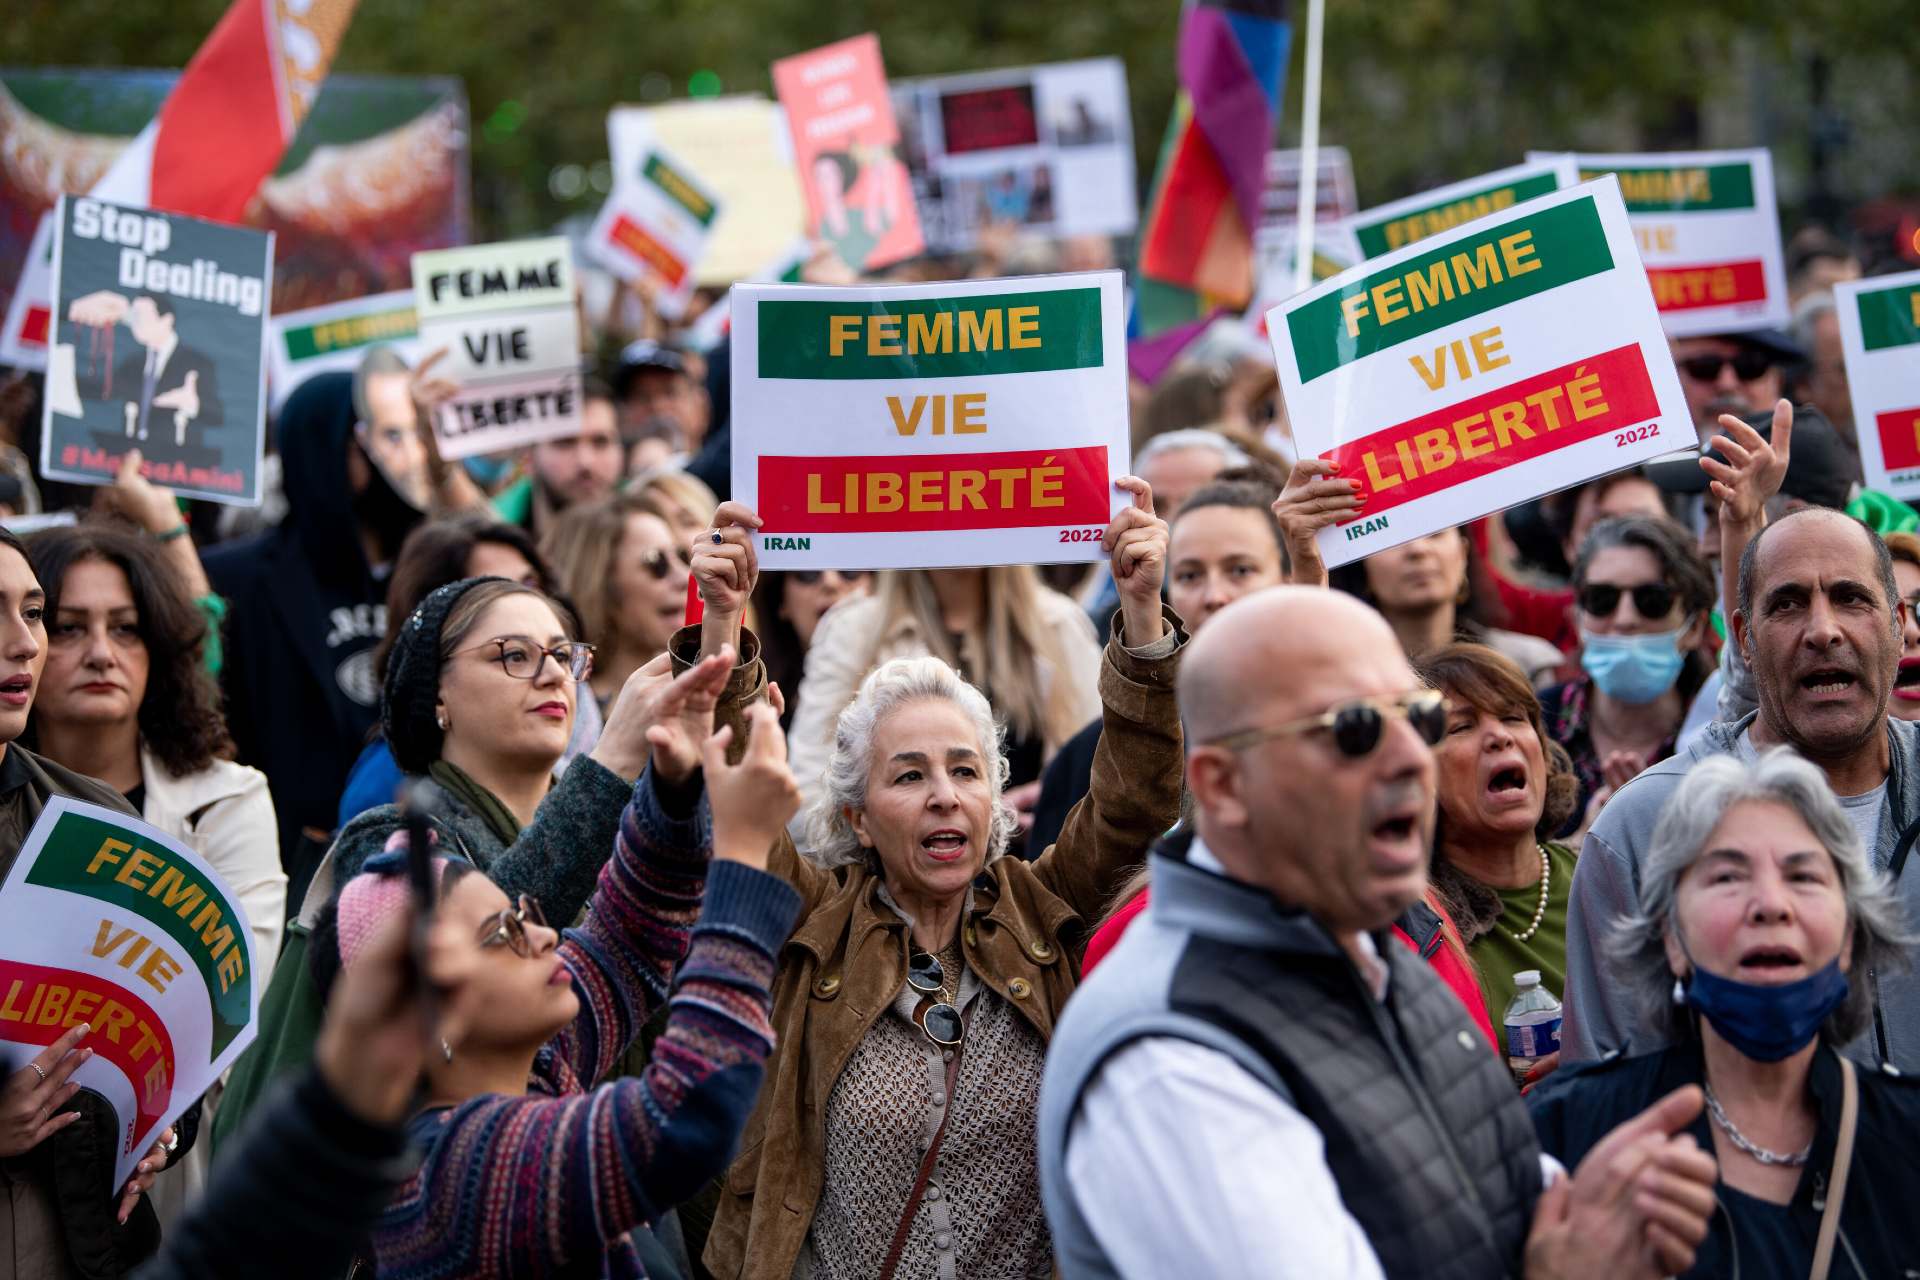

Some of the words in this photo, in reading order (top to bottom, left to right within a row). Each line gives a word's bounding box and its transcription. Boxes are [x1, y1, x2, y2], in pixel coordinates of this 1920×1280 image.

[72, 200, 171, 255] Stop
[119, 247, 264, 317] Dealing
[429, 258, 562, 302] FEMME
[1340, 229, 1543, 338] FEMME
[462, 327, 531, 365] VIE
[829, 305, 1042, 357] FEMME
[1407, 326, 1512, 391] VIE
[434, 374, 574, 439] LIBERTÉ
[885, 392, 988, 437] VIE
[1361, 366, 1610, 494] LIBERTÉ
[1614, 422, 1661, 448] 2022
[807, 456, 1065, 514] LIBERTÉ
[764, 537, 811, 551] IRAN
[1059, 528, 1103, 543] 2022
[1345, 515, 1390, 541] IRAN
[85, 837, 245, 994] FEMME
[89, 919, 184, 995] VIE
[0, 979, 172, 1105] LIBERTÉ
